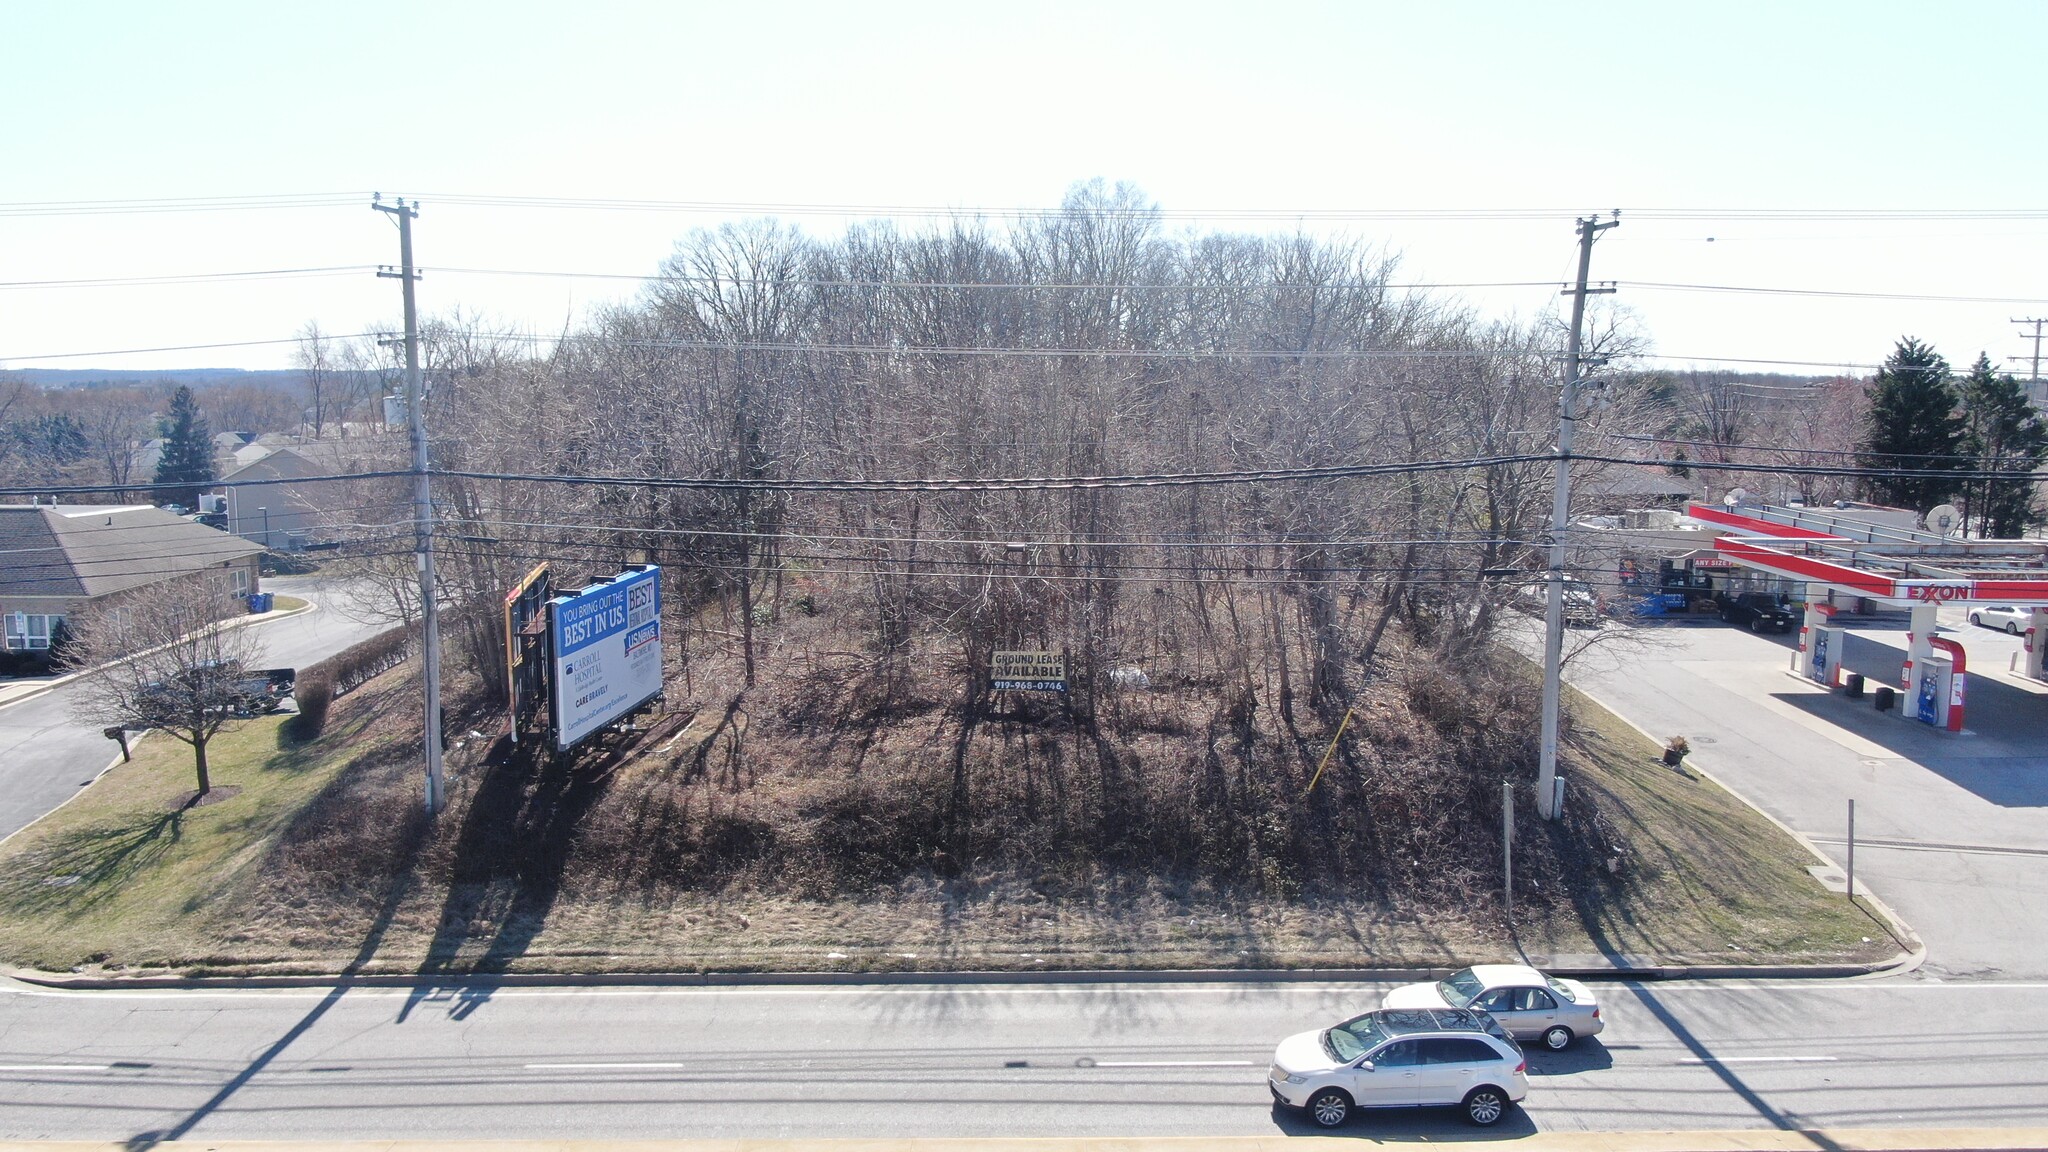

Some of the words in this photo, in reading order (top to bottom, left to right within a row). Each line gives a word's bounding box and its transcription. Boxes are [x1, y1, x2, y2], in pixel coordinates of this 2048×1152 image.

[628, 582, 653, 611] BEST
[1907, 583, 1969, 606] EXXON
[563, 609, 578, 624] YOU
[578, 600, 598, 618] BRING
[598, 595, 611, 610] OUT
[612, 590, 624, 604] THE
[563, 617, 592, 647] BEST
[595, 611, 607, 634] IN
[609, 605, 625, 628] US.
[573, 650, 601, 671] CARROLL
[995, 654, 1034, 665] GROUND
[1037, 654, 1063, 665] LEASE
[574, 662, 602, 685] HOSPITAL
[995, 666, 1062, 677] AVAILABLE
[575, 694, 589, 708] CARE
[589, 684, 609, 702] BRAVELY
[994, 681, 1062, 690] 919-968-0746
